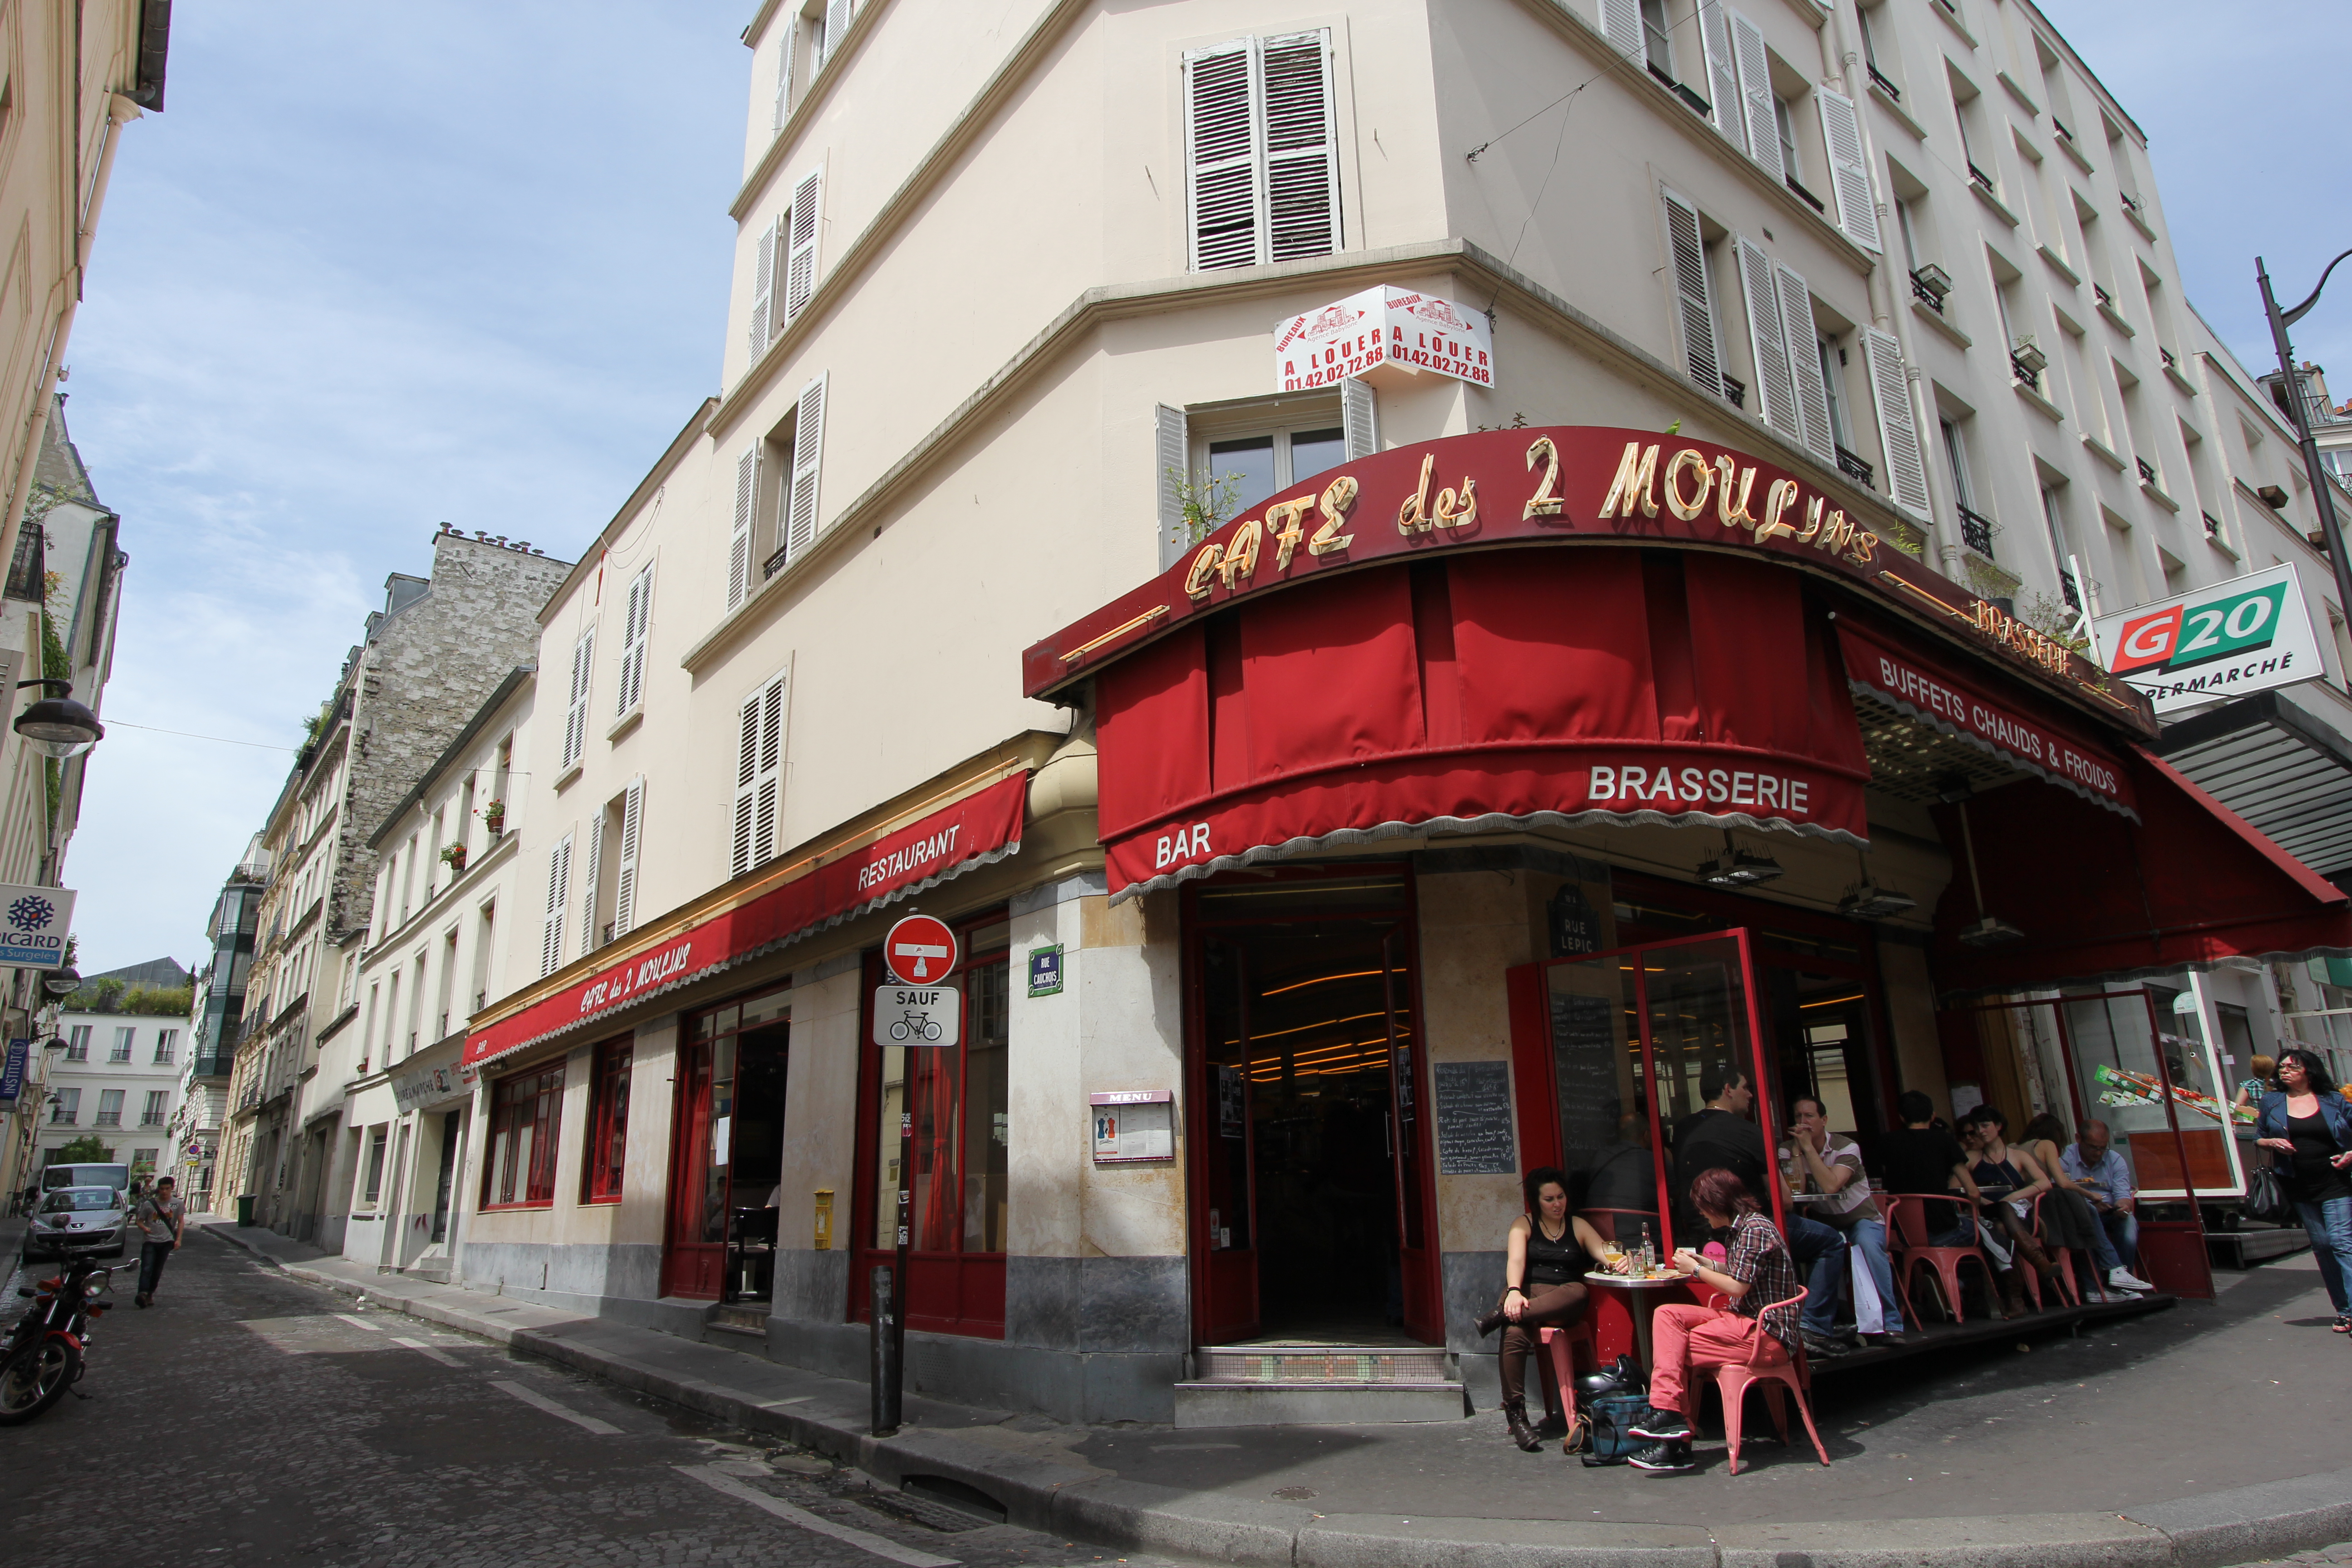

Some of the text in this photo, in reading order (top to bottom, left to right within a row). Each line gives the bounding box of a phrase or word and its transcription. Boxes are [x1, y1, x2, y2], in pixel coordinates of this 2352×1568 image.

[1386, 293, 1423, 310] BUREAUX
[1276, 316, 1306, 353] BUREAUX
[1307, 319, 1358, 343] Agence Babylone
[1416, 314, 1466, 334] Agence Babylone
[1284, 328, 1381, 377] A LOUER
[1392, 326, 1488, 367] A LOUER
[1392, 343, 1490, 384] 01.42.02.72.88
[1285, 346, 1383, 391] 01.42.02.72.88
[1397, 452, 1476, 536] des
[1522, 435, 1564, 522] 2
[1598, 441, 1877, 568] MOULINS
[1974, 599, 2072, 679] BRASSERIE
[2124, 595, 2272, 658] G20
[2145, 651, 2293, 701] PERMARCHÉ
[1880, 657, 2117, 794] BUFFETS CHAUDS & FROIDS
[1588, 765, 1809, 813] BRASSERIE
[858, 823, 960, 892] RESTAURANT
[1155, 822, 1211, 869] BAR
[1562, 936, 1592, 953] LEPIC
[1565, 919, 1586, 935] RUE
[7, 948, 56, 960] Surgelés
[609, 976, 622, 999] des
[623, 967, 633, 996] 2
[634, 942, 691, 990] MOULINS
[1041, 956, 1050, 968] RUE
[1034, 970, 1057, 985] CAUCHOIS
[896, 991, 939, 1005] SAUF
[476, 1039, 487, 1054] BAR
[4, 1055, 22, 1093] INSTITUT
[396, 1078, 434, 1103] SUPERMARCHÉ
[1109, 1093, 1152, 1102] MENU
